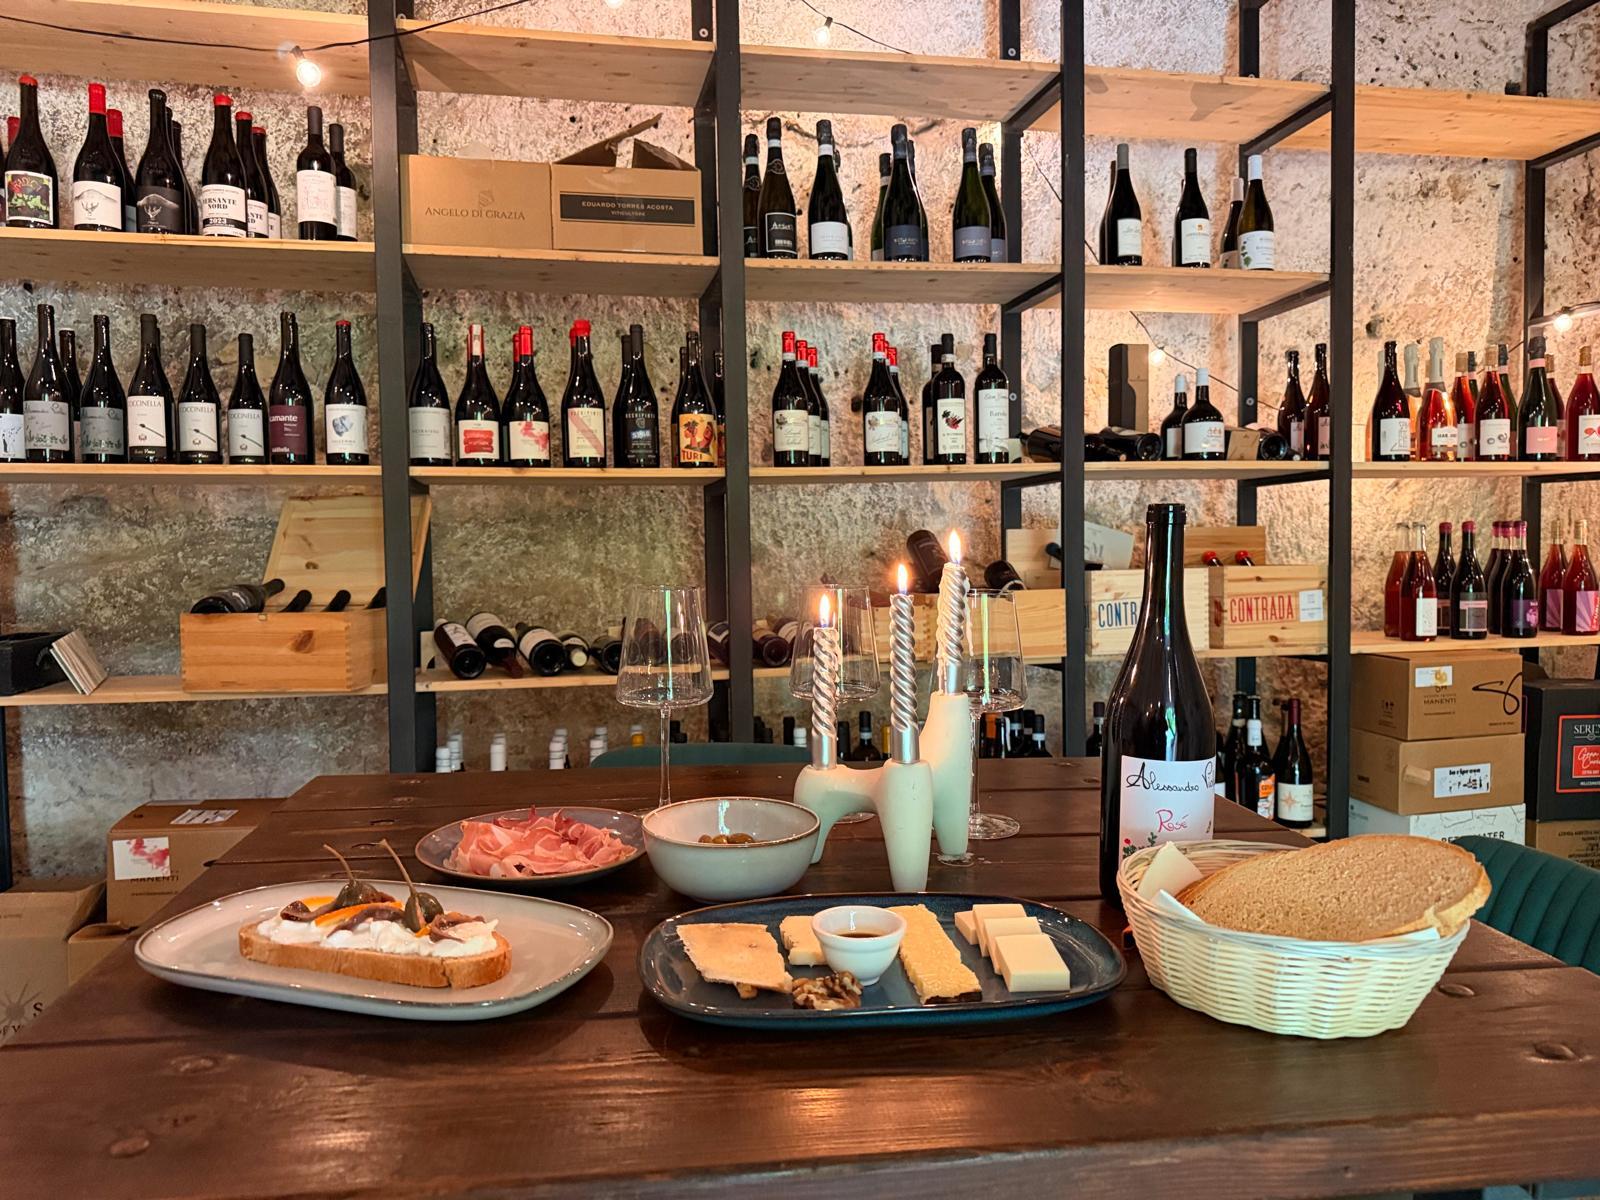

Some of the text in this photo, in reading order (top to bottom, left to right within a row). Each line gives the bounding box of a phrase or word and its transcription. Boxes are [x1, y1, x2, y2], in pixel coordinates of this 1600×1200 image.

[425, 207, 526, 220] ANGELO DI GRAZIA
[1098, 601, 1138, 628] CONTR
[1230, 594, 1294, 624] CONTRADA
[1423, 697, 1456, 705] MANENTI
[1126, 761, 1200, 792] Alessandro
[1155, 808, 1190, 833] Rosé
